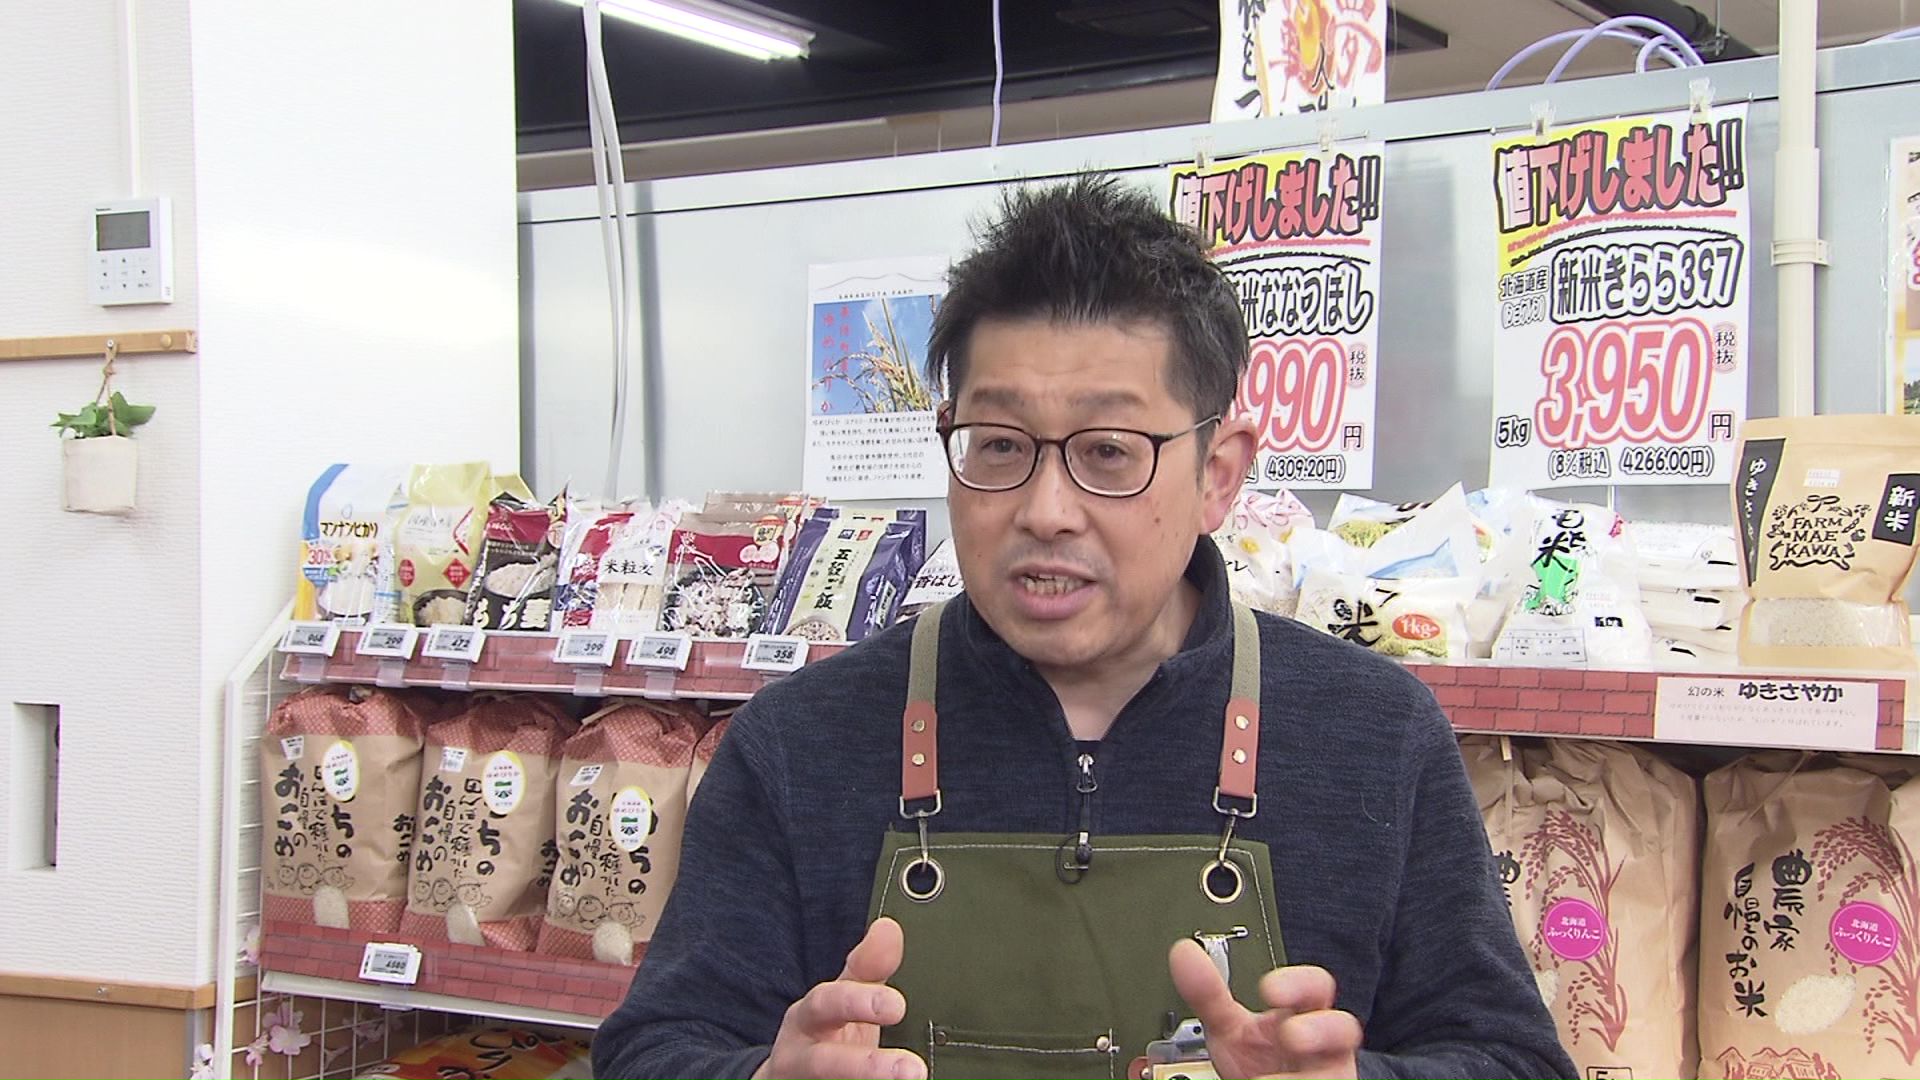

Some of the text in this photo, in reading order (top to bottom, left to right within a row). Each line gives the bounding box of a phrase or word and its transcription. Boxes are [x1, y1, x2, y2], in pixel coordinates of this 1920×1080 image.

[1555, 244, 1738, 319] 新米きらら397
[1234, 264, 1372, 335] 米ななつぼし
[1715, 331, 1735, 364] 税抜
[1350, 350, 1366, 381] 税抜
[1539, 323, 1707, 446] 3,950
[1343, 425, 1362, 448] 円
[1498, 419, 1530, 447] 5kg
[1711, 414, 1732, 438] 円
[1792, 517, 1842, 529] FARM
[1884, 485, 1916, 532] 新米
[1784, 543, 1841, 558] KAWA
[1793, 530, 1839, 543] MAE
[1401, 618, 1437, 633] 1kg
[1738, 682, 1843, 703] ゆきさやか
[274, 762, 304, 858] おこめ
[416, 775, 451, 873] おこめ
[560, 789, 599, 886] おこめ
